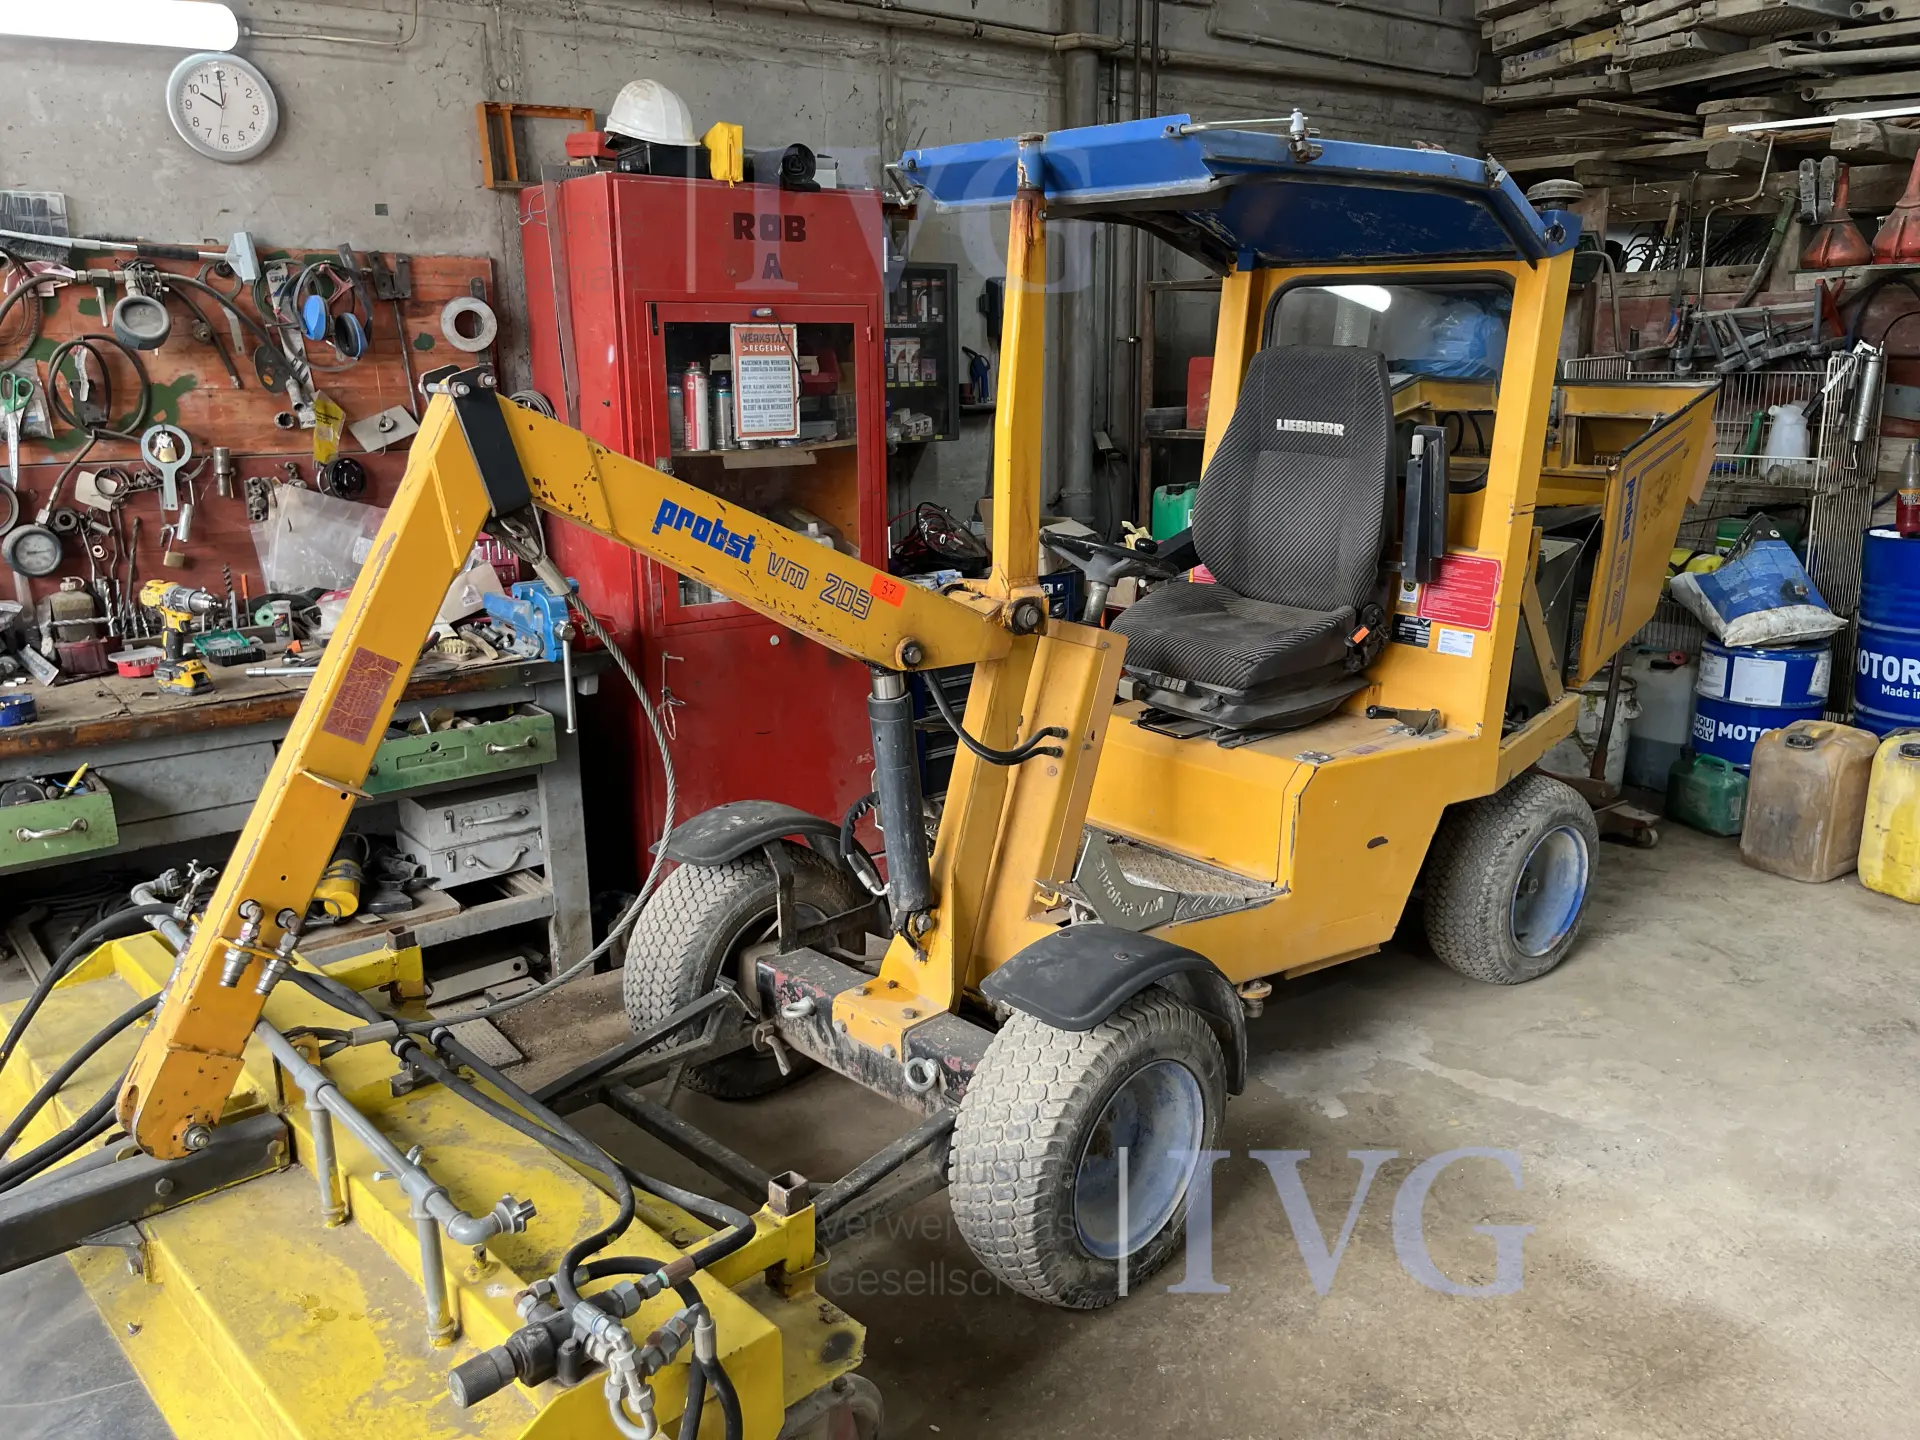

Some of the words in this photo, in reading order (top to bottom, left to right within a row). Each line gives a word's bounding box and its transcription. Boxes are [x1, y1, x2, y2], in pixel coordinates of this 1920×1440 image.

[199, 74, 209, 84] 11
[234, 76, 239, 86] 1
[188, 84, 199, 94] 10
[246, 88, 252, 98] 2
[185, 100, 192, 110] 9
[252, 105, 259, 115] 3
[192, 117, 200, 127] 8
[249, 122, 256, 131] 4
[205, 128, 212, 138] 7
[238, 131, 245, 140] 5
[222, 134, 229, 144] 6
[732, 211, 806, 242] ROB
[762, 253, 784, 279] A
[739, 332, 791, 344] WERKSTATT
[749, 344, 780, 352] REGELN
[1276, 418, 1344, 436] LIEBHERR
[651, 498, 756, 564] probst
[819, 572, 874, 620] 203
[1882, 684, 1910, 698] Made
